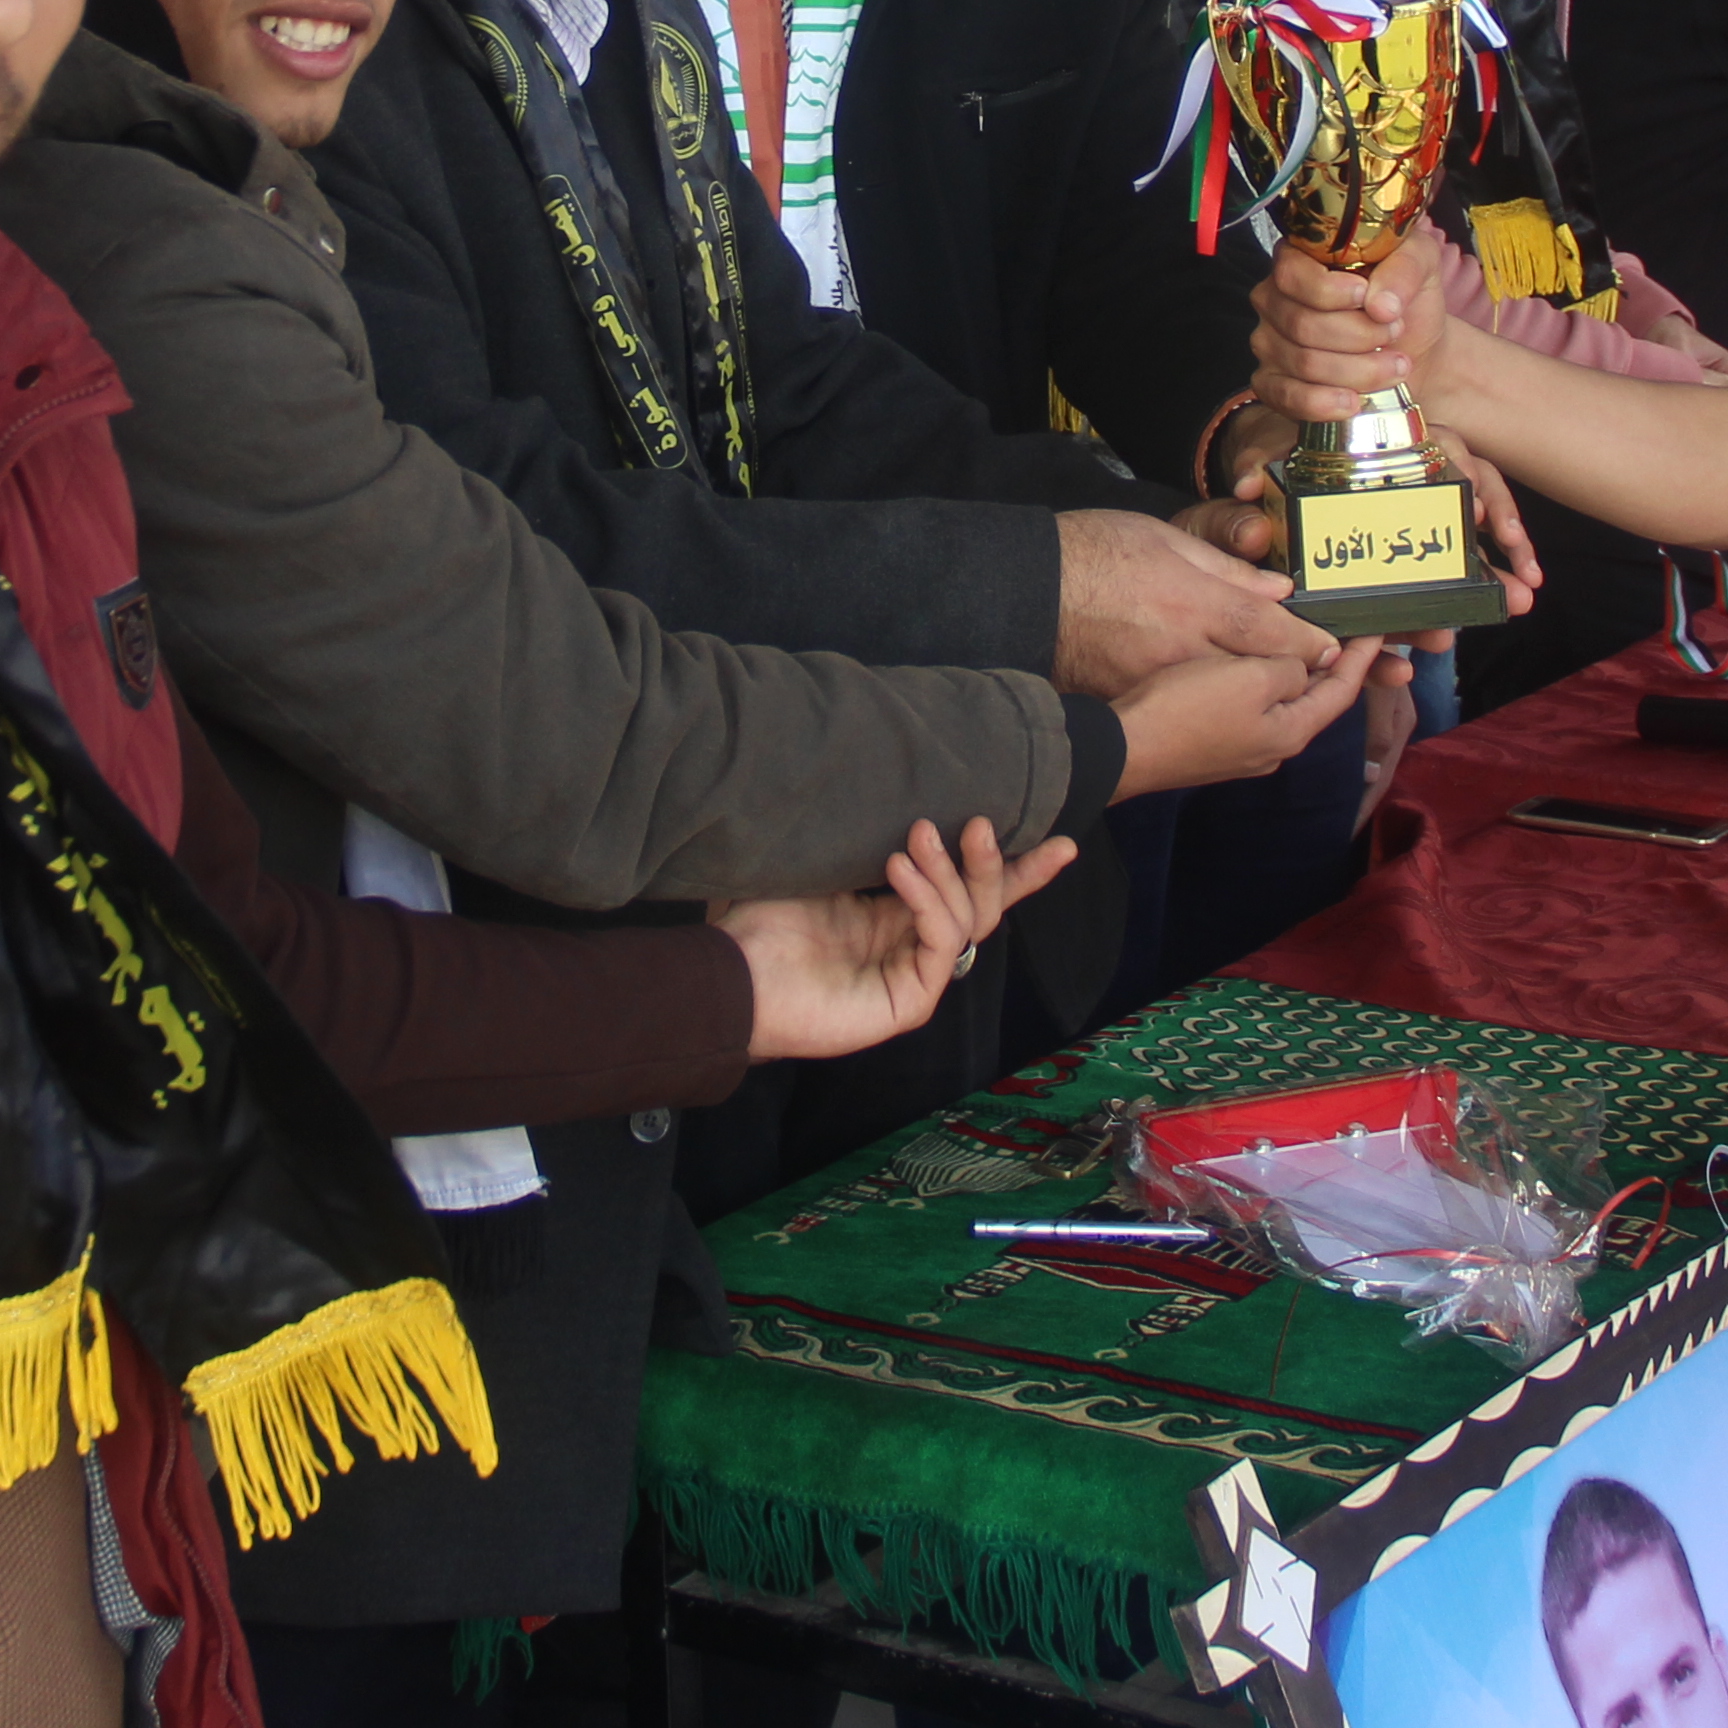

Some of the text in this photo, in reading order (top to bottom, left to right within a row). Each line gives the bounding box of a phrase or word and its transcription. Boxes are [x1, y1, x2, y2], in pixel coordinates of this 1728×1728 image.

[544, 193, 597, 266] إيمان
[592, 294, 641, 357] وعي
[629, 387, 678, 455] ثورة
[1313, 525, 1453, 569] المركز الأول
